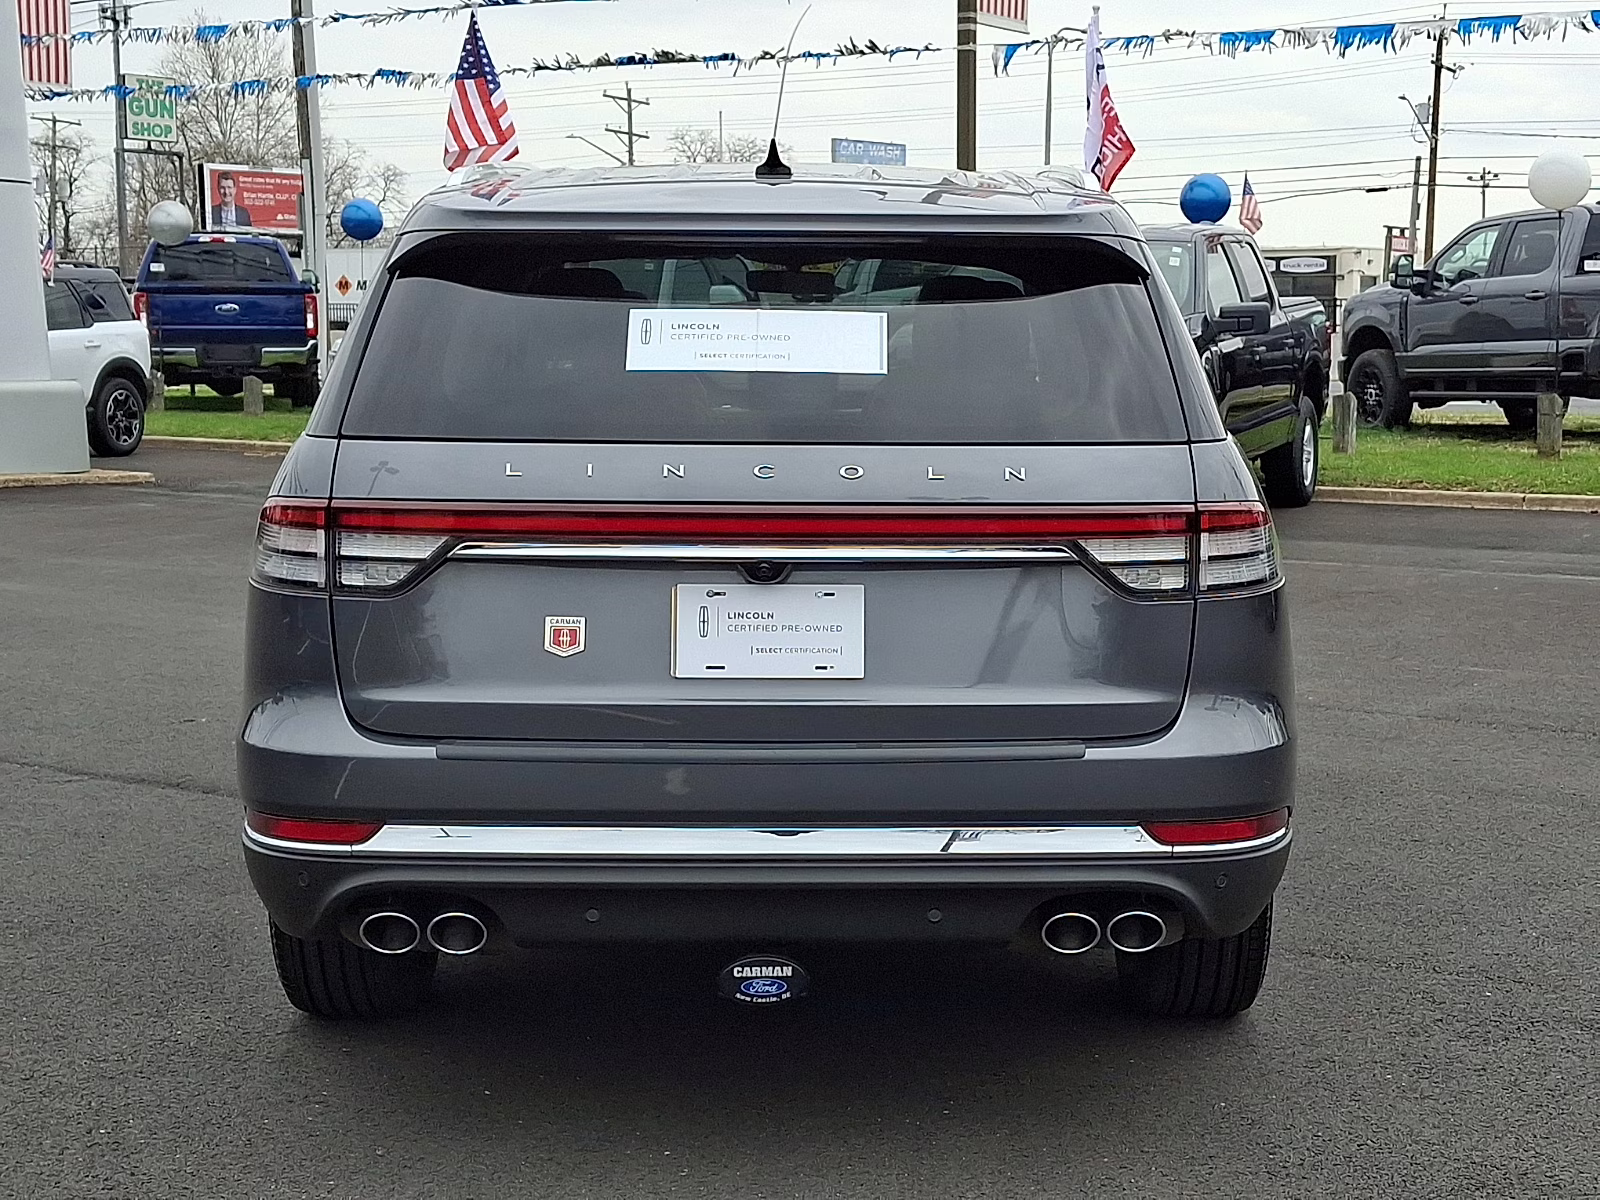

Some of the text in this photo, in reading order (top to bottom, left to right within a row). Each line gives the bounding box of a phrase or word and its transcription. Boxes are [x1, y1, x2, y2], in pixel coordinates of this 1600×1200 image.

[128, 97, 174, 119] GUN
[131, 121, 173, 138] SHOP
[840, 141, 901, 159] CAR WASH
[670, 333, 791, 342] CERTIFIED PRE-OWNED
[504, 462, 1027, 482] LINCOLN
[727, 611, 774, 620] LINCOLN
[727, 624, 843, 633] CERTIFIED PRE-OWNED
[733, 966, 793, 977] CARMAN
[749, 980, 779, 992] Ford
[734, 992, 752, 1002] New
[781, 991, 792, 1000] DE
